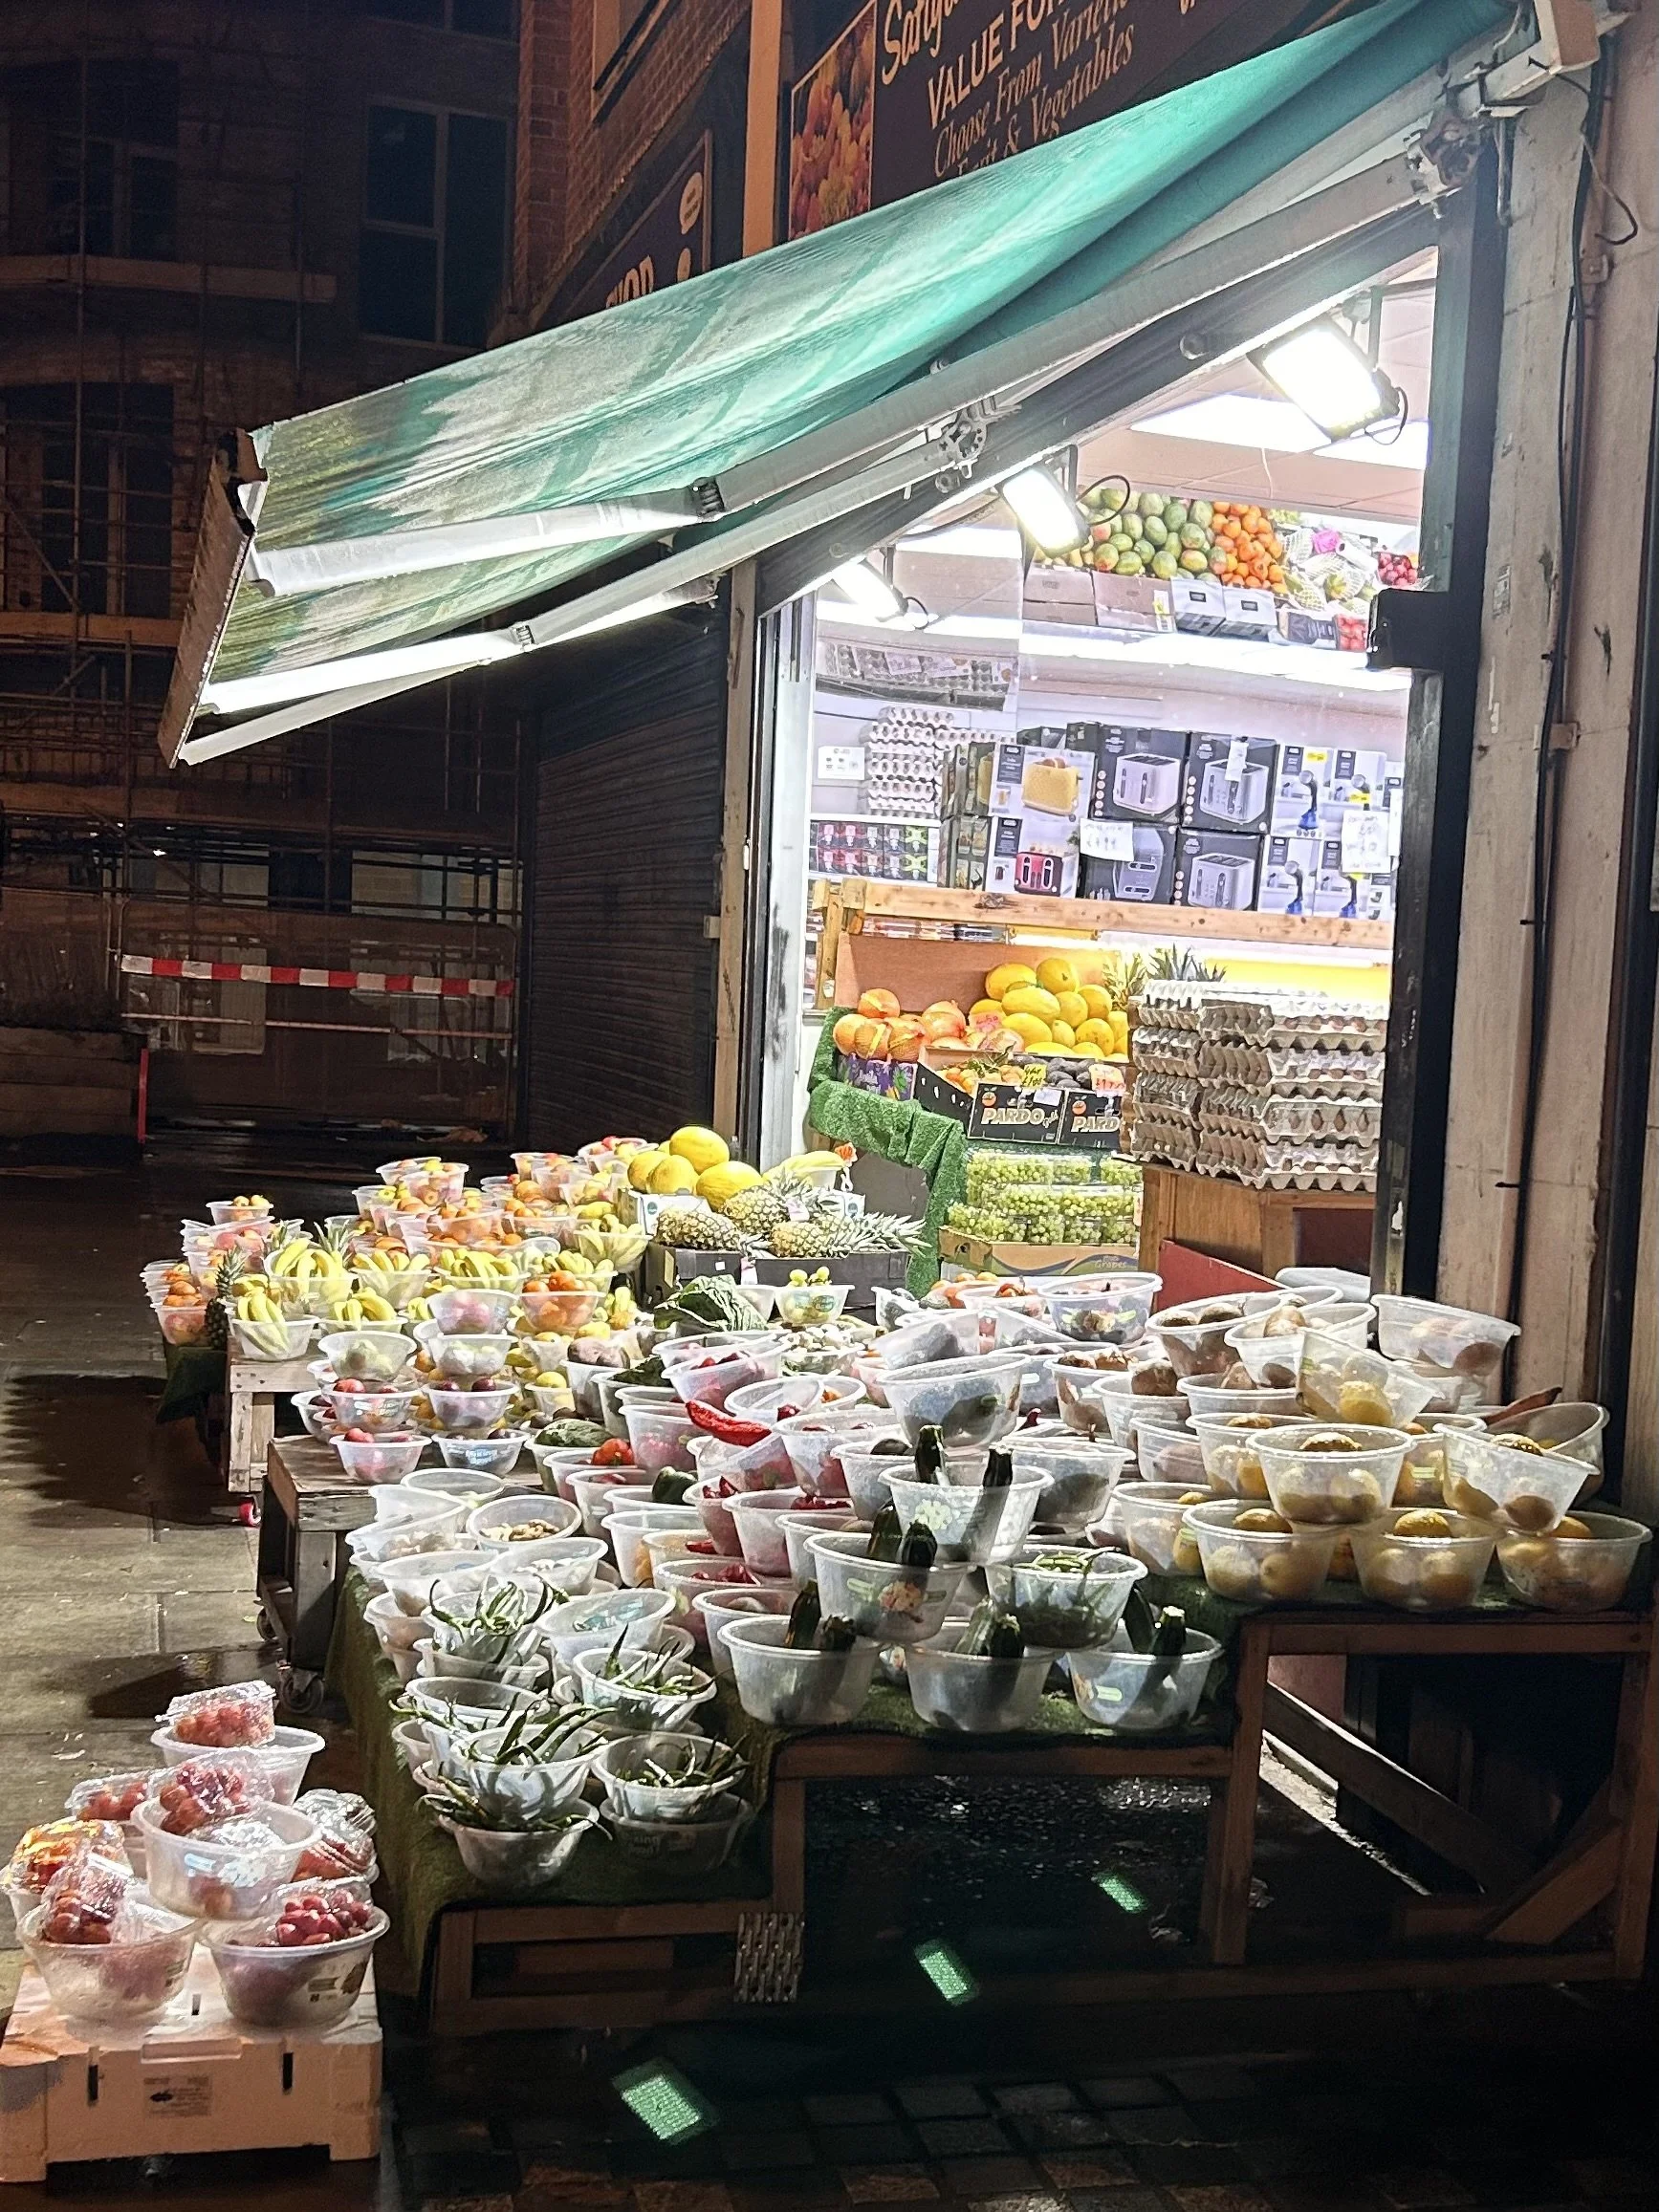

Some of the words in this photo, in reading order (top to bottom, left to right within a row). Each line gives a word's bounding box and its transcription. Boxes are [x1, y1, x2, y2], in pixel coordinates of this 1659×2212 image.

[928, 11, 1004, 130] VALUE
[935, 101, 991, 178] Choose
[994, 51, 1042, 124] From
[1052, 0, 1127, 70] Varie
[1032, 23, 1134, 142] Vegetables
[981, 1107, 1045, 1125] PARDO
